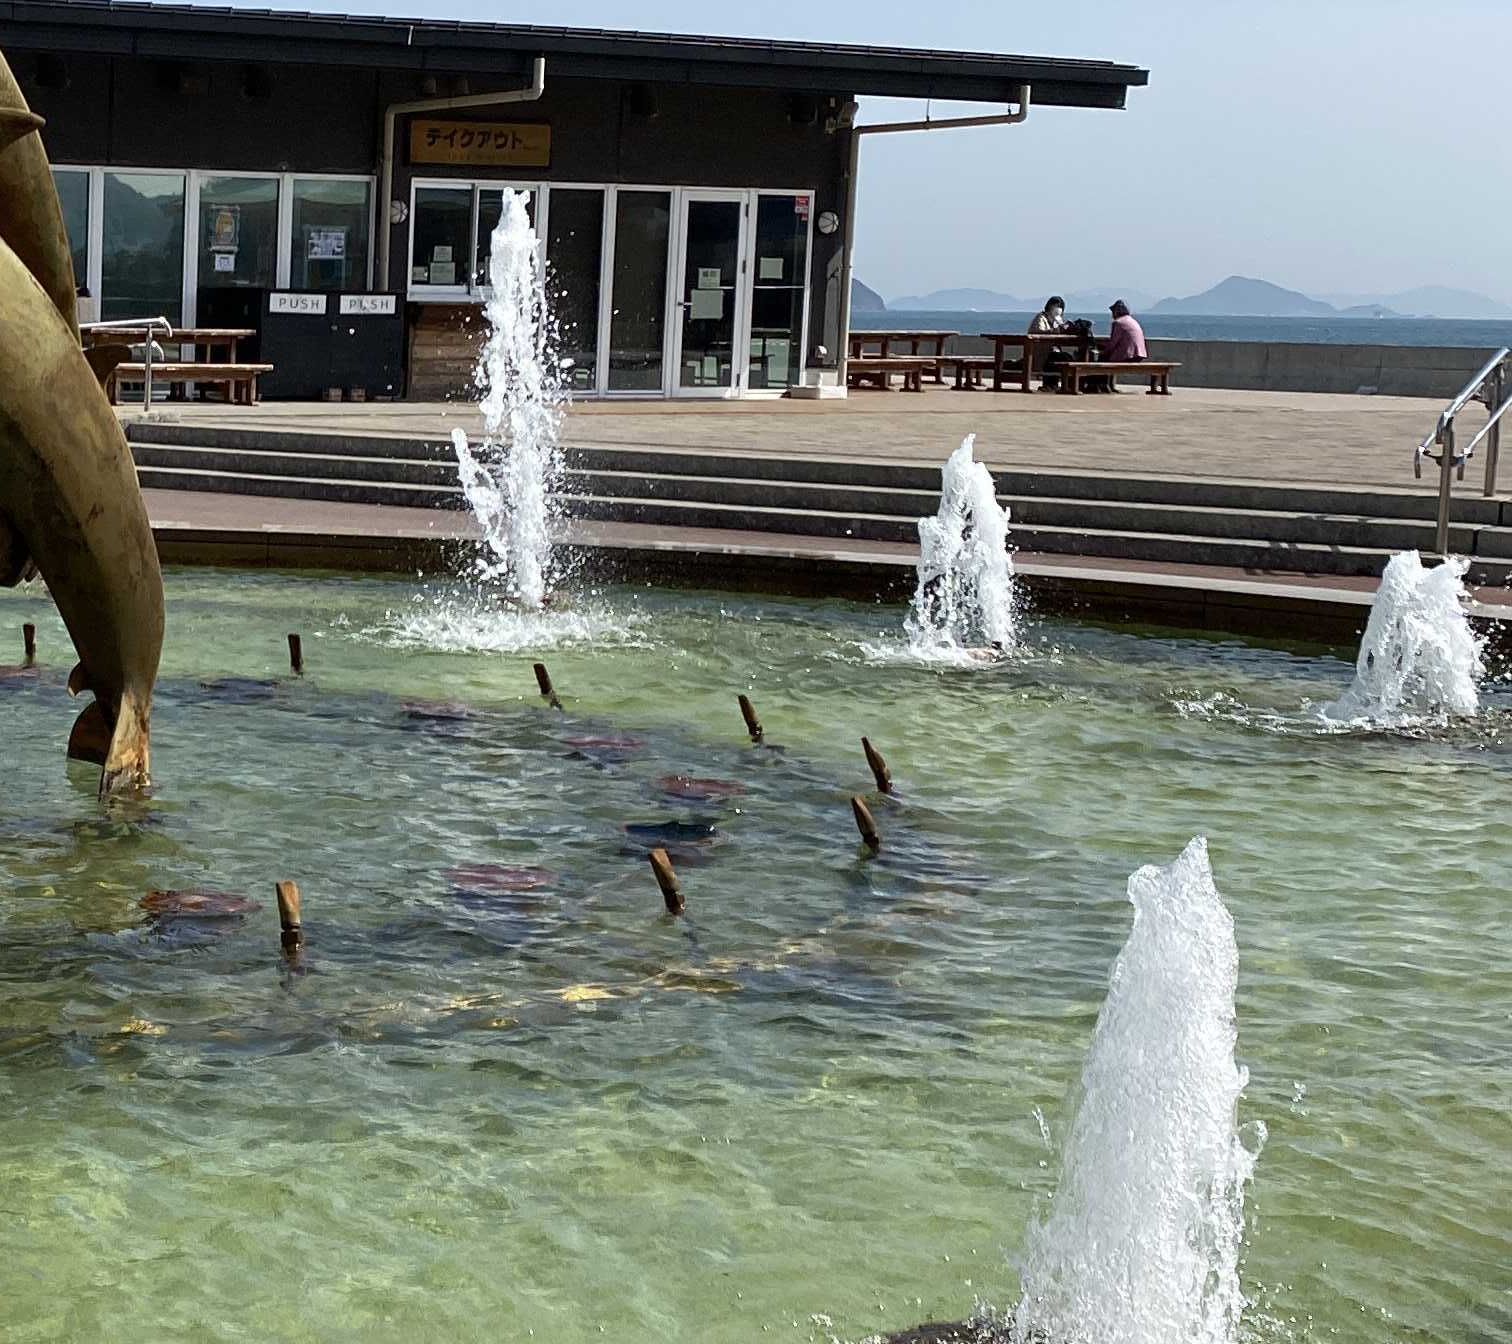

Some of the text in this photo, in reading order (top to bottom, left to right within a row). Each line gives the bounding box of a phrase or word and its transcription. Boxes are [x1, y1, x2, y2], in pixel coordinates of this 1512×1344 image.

[425, 127, 523, 150] テイクアウト
[279, 298, 320, 310] PUSH
